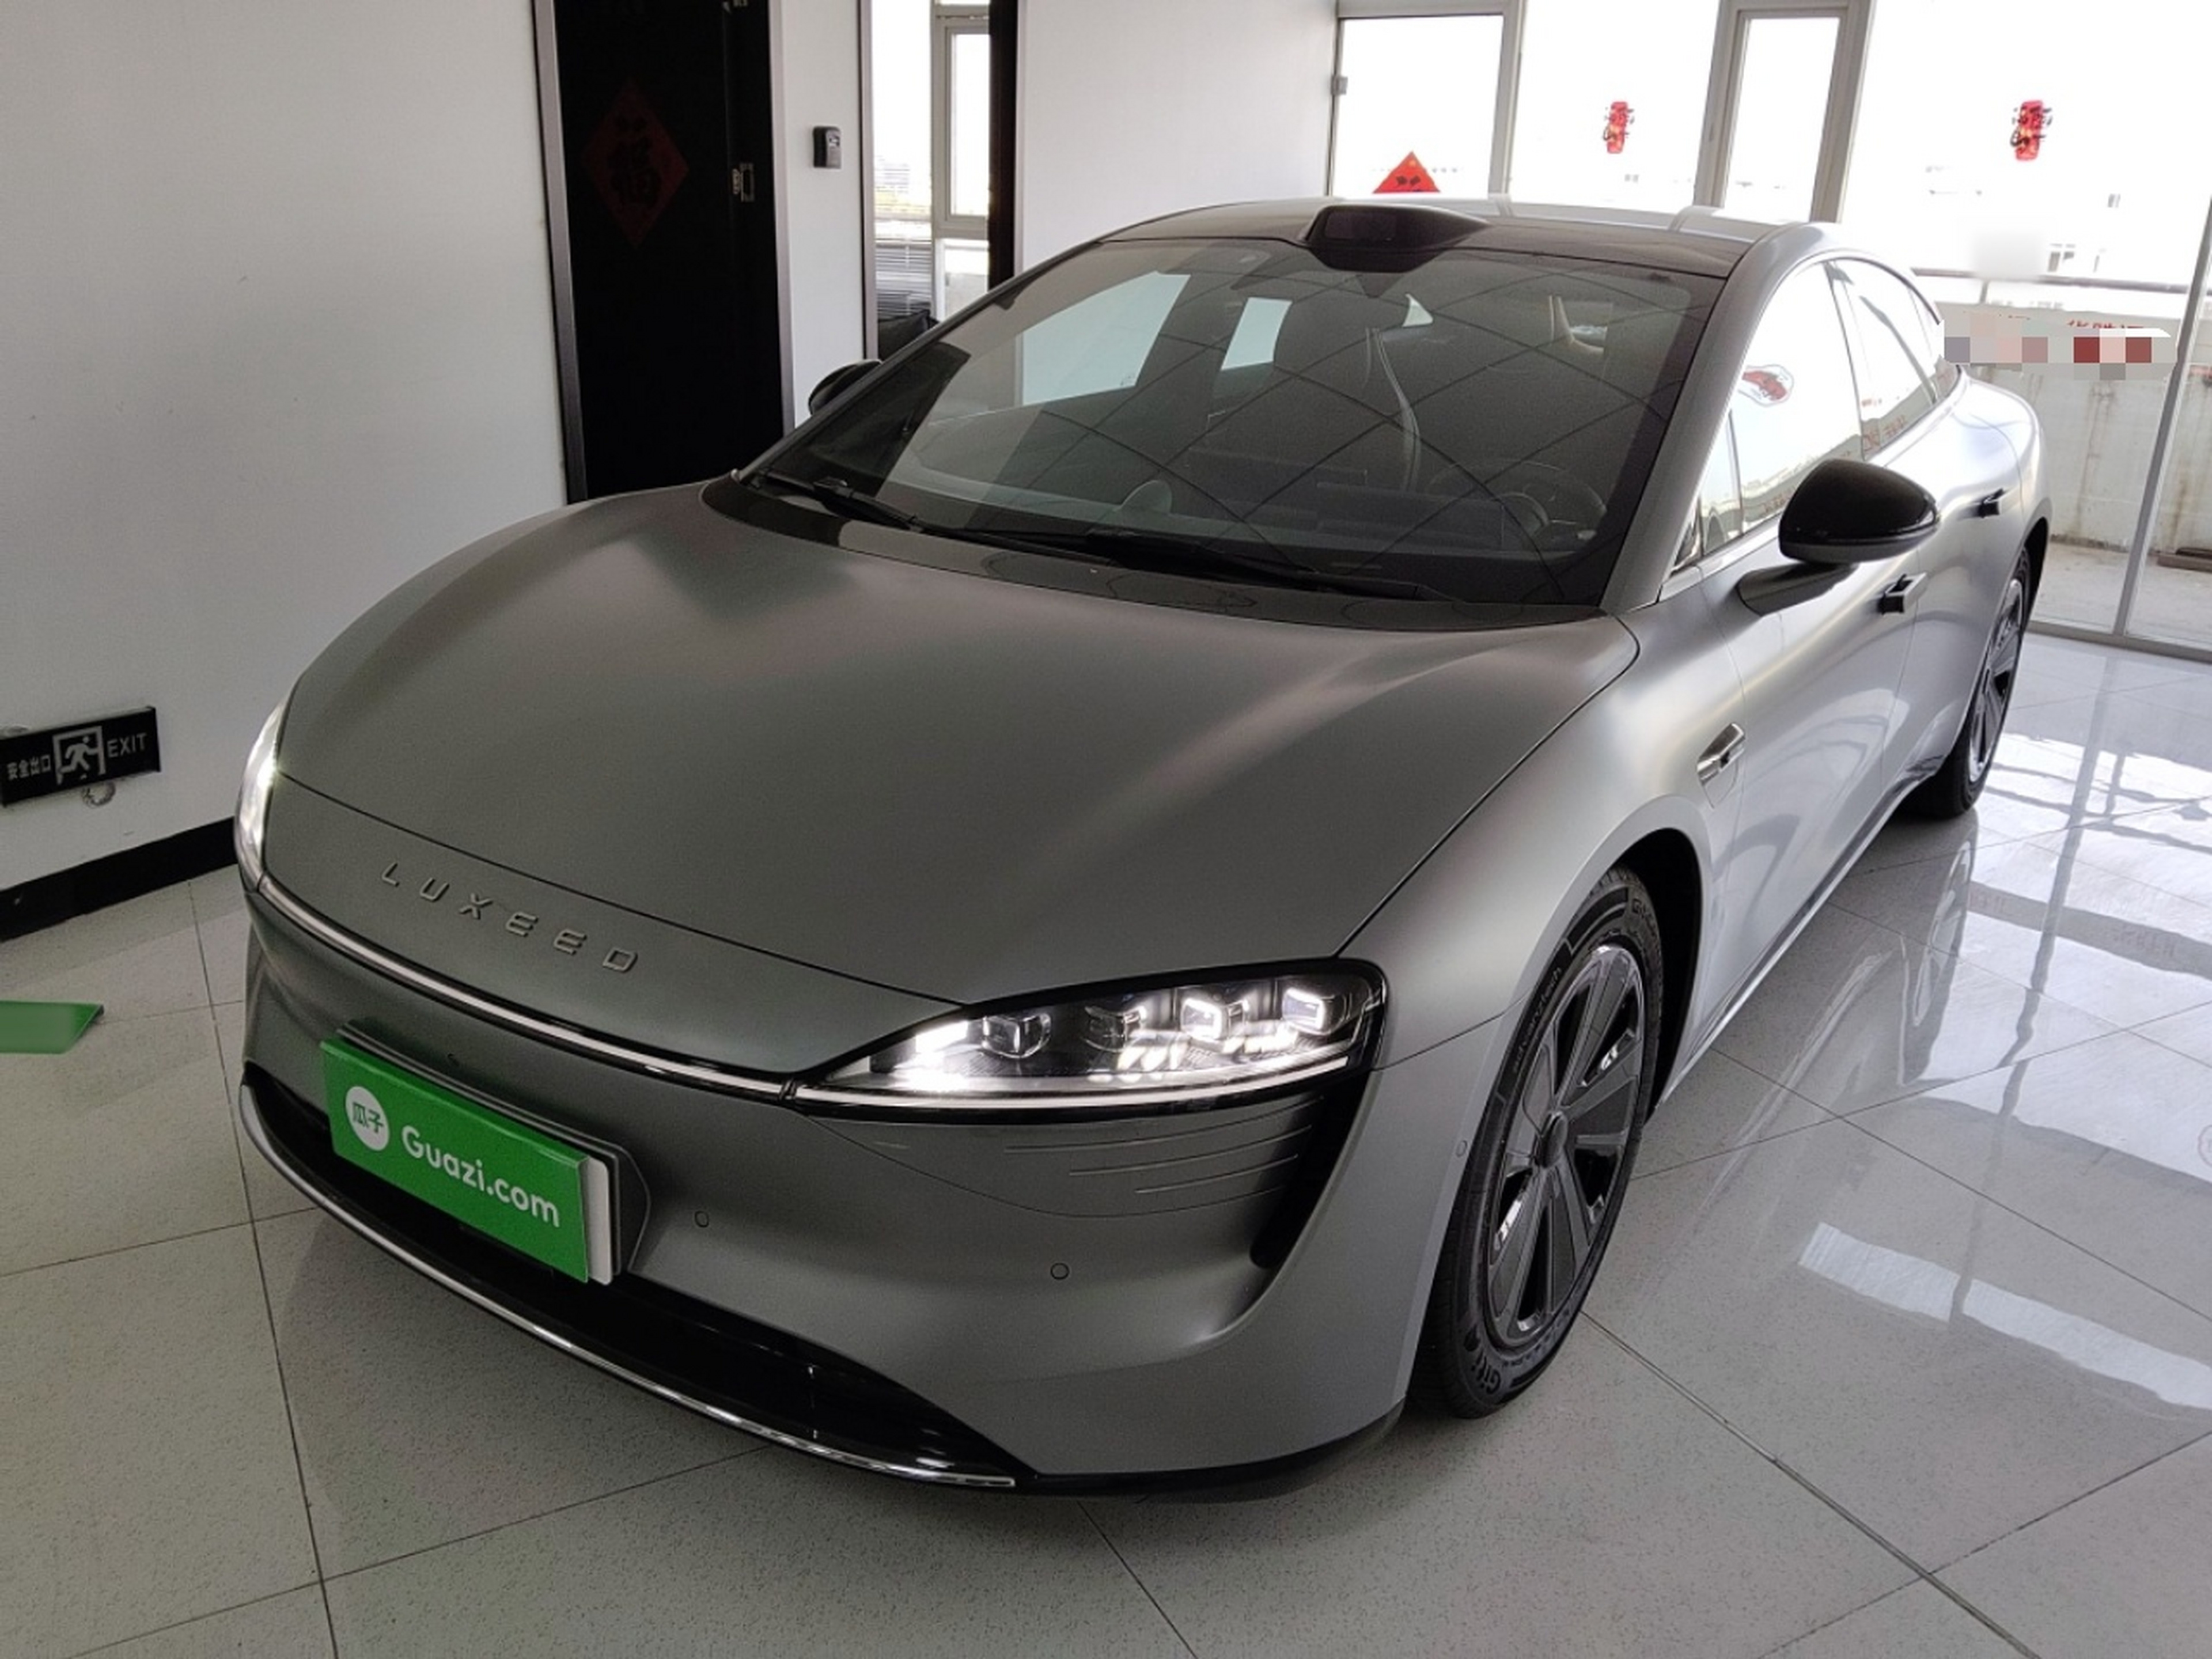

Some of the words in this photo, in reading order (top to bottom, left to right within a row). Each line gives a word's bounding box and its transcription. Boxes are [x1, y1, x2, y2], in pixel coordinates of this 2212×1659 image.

[107, 733, 147, 758] EXIT
[381, 862, 638, 973] LUXEED
[351, 1101, 385, 1134] 瓜子
[402, 1126, 560, 1228] Guazi.com
